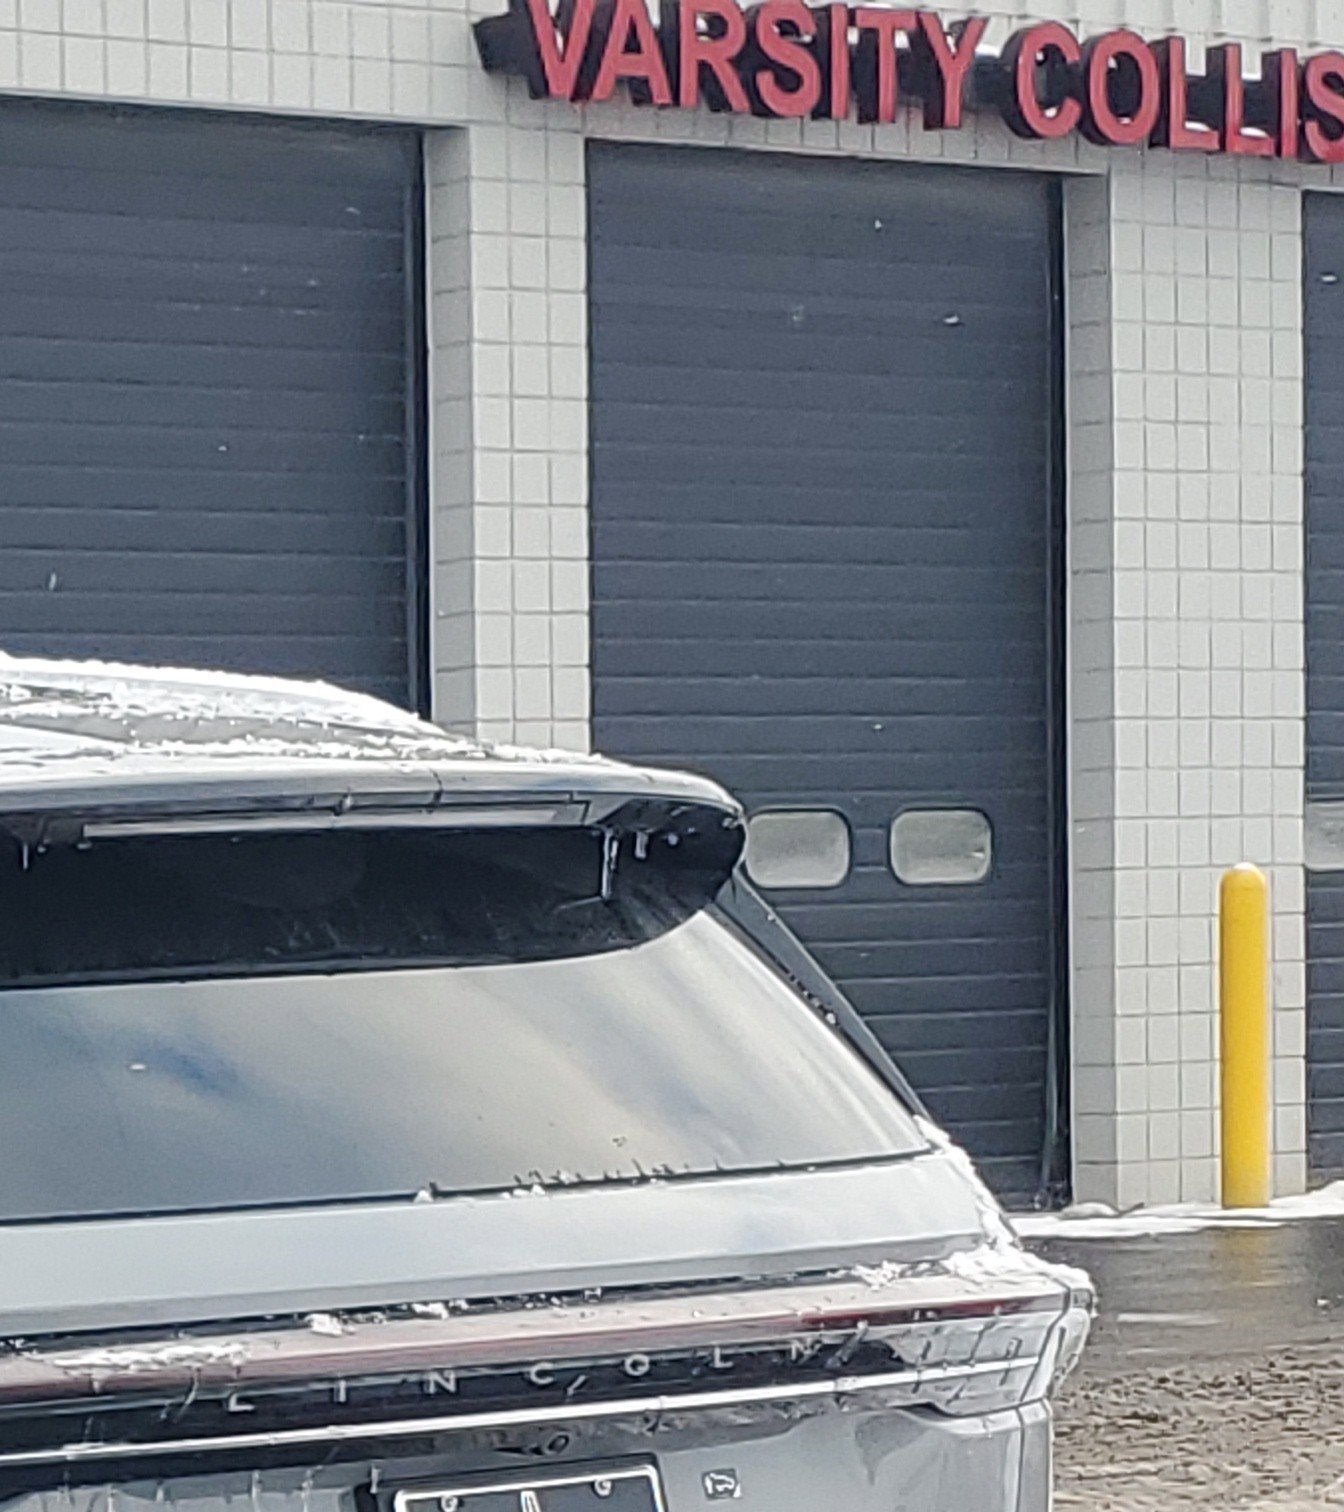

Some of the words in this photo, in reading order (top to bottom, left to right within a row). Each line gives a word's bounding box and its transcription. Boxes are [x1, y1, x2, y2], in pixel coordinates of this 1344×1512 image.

[527, 0, 990, 130] VARSITY
[1017, 20, 1344, 164] COLLIS
[228, 1340, 818, 1412] LINCOLN
